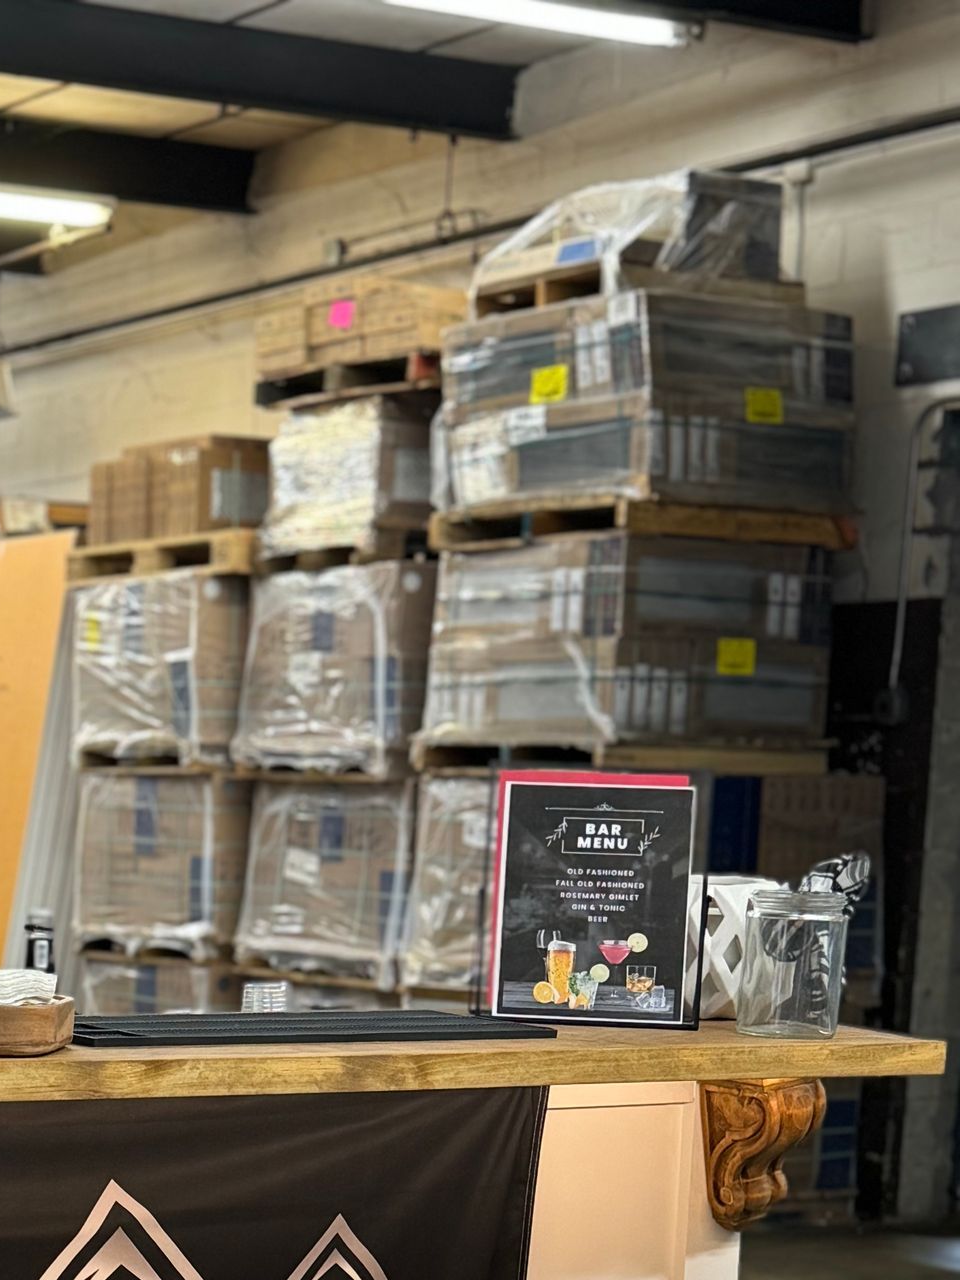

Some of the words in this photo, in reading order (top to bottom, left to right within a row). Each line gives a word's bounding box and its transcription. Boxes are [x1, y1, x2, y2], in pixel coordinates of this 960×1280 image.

[585, 823, 622, 836] BAR
[576, 836, 629, 850] MENU
[586, 868, 635, 877] FASHIONED
[555, 879, 574, 887] FALL
[577, 880, 594, 888] OLD
[596, 881, 645, 889] FASHIONED
[560, 891, 606, 900] ROSEMARY
[608, 893, 640, 901] GIMLET
[599, 904, 626, 912] TONIC
[587, 915, 608, 923] BEER
